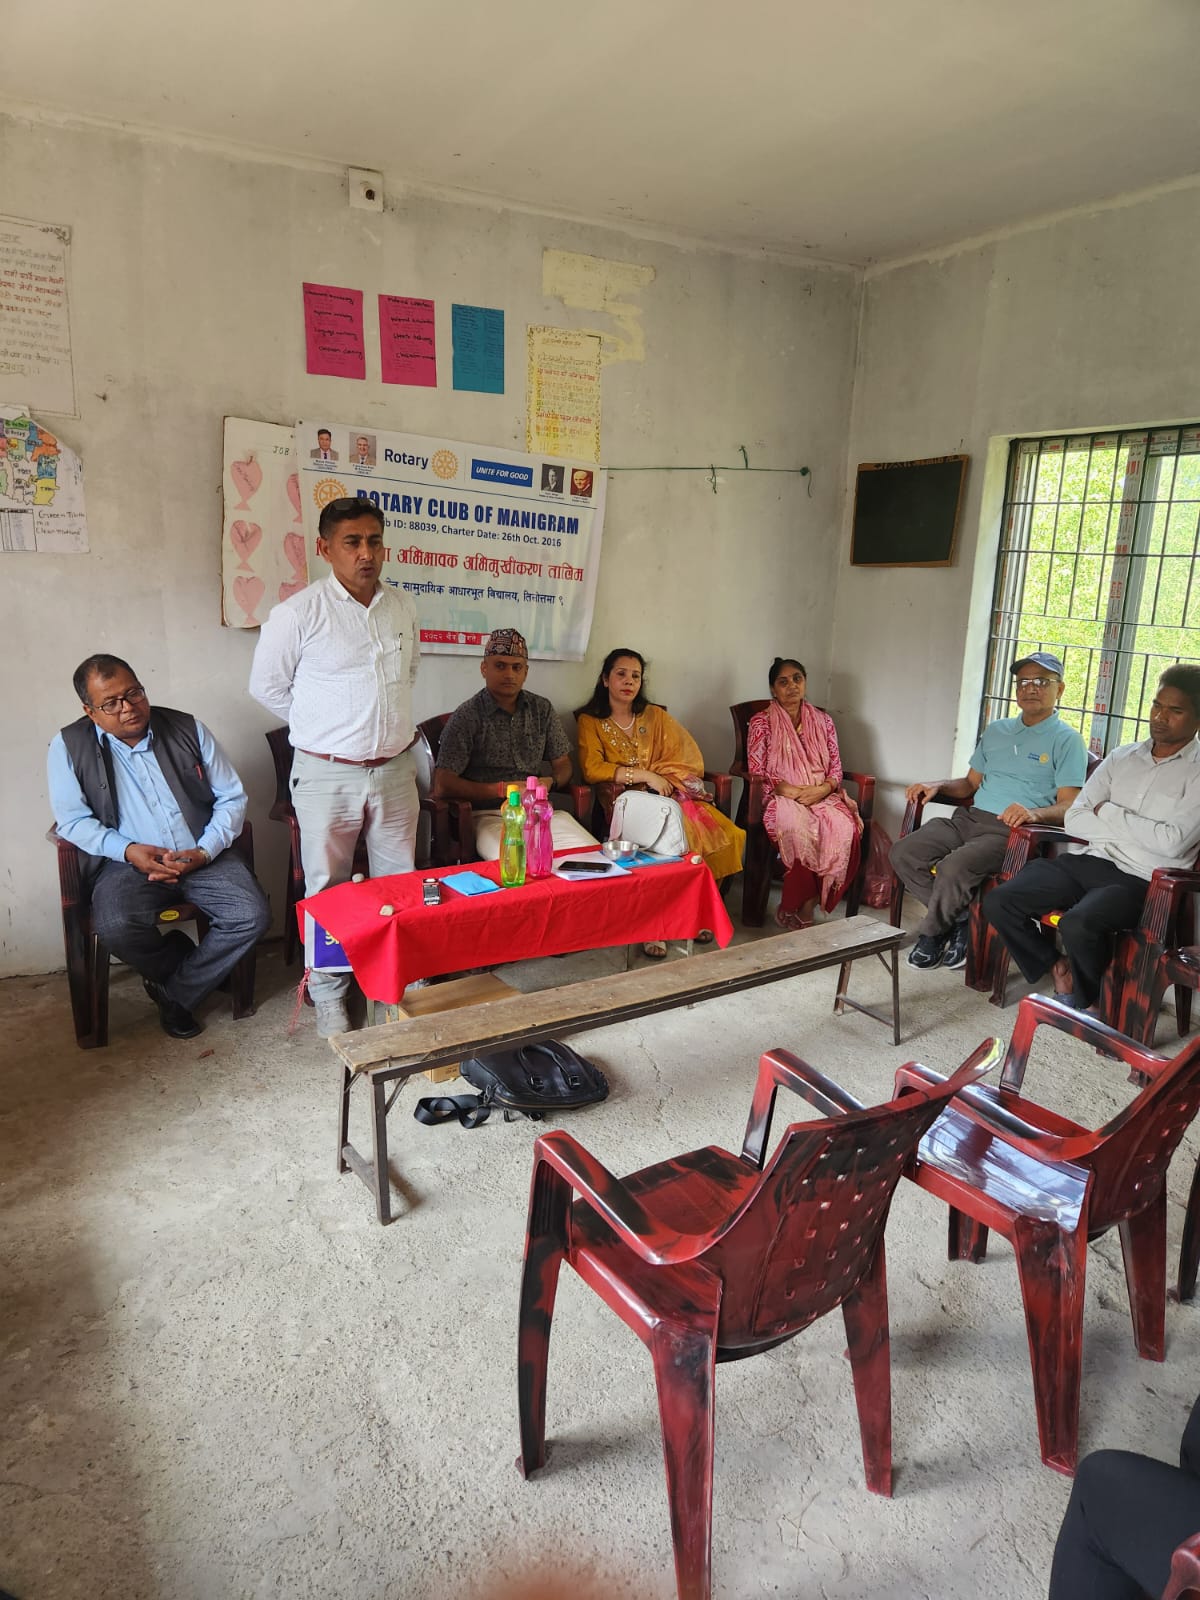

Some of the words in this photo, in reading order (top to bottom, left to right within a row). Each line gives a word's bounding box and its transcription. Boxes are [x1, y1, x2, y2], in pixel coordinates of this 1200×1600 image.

[384, 448, 429, 470] Rotary
[476, 466, 495, 476] UNITE
[496, 469, 509, 478] FOR
[509, 472, 529, 481] GOOD
[427, 498, 469, 521] CLUB
[474, 504, 494, 523] OF
[497, 507, 580, 535] MANIGRAM
[393, 519, 407, 529] ID:
[409, 521, 439, 534] 88039,
[441, 524, 475, 537] Charter
[477, 529, 500, 540] Date:
[502, 532, 521, 543] 26th
[523, 534, 540, 545] Oct.
[541, 536, 562, 548] 2016
[397, 545, 458, 569] अभिभावक
[547, 562, 584, 582] तालिम
